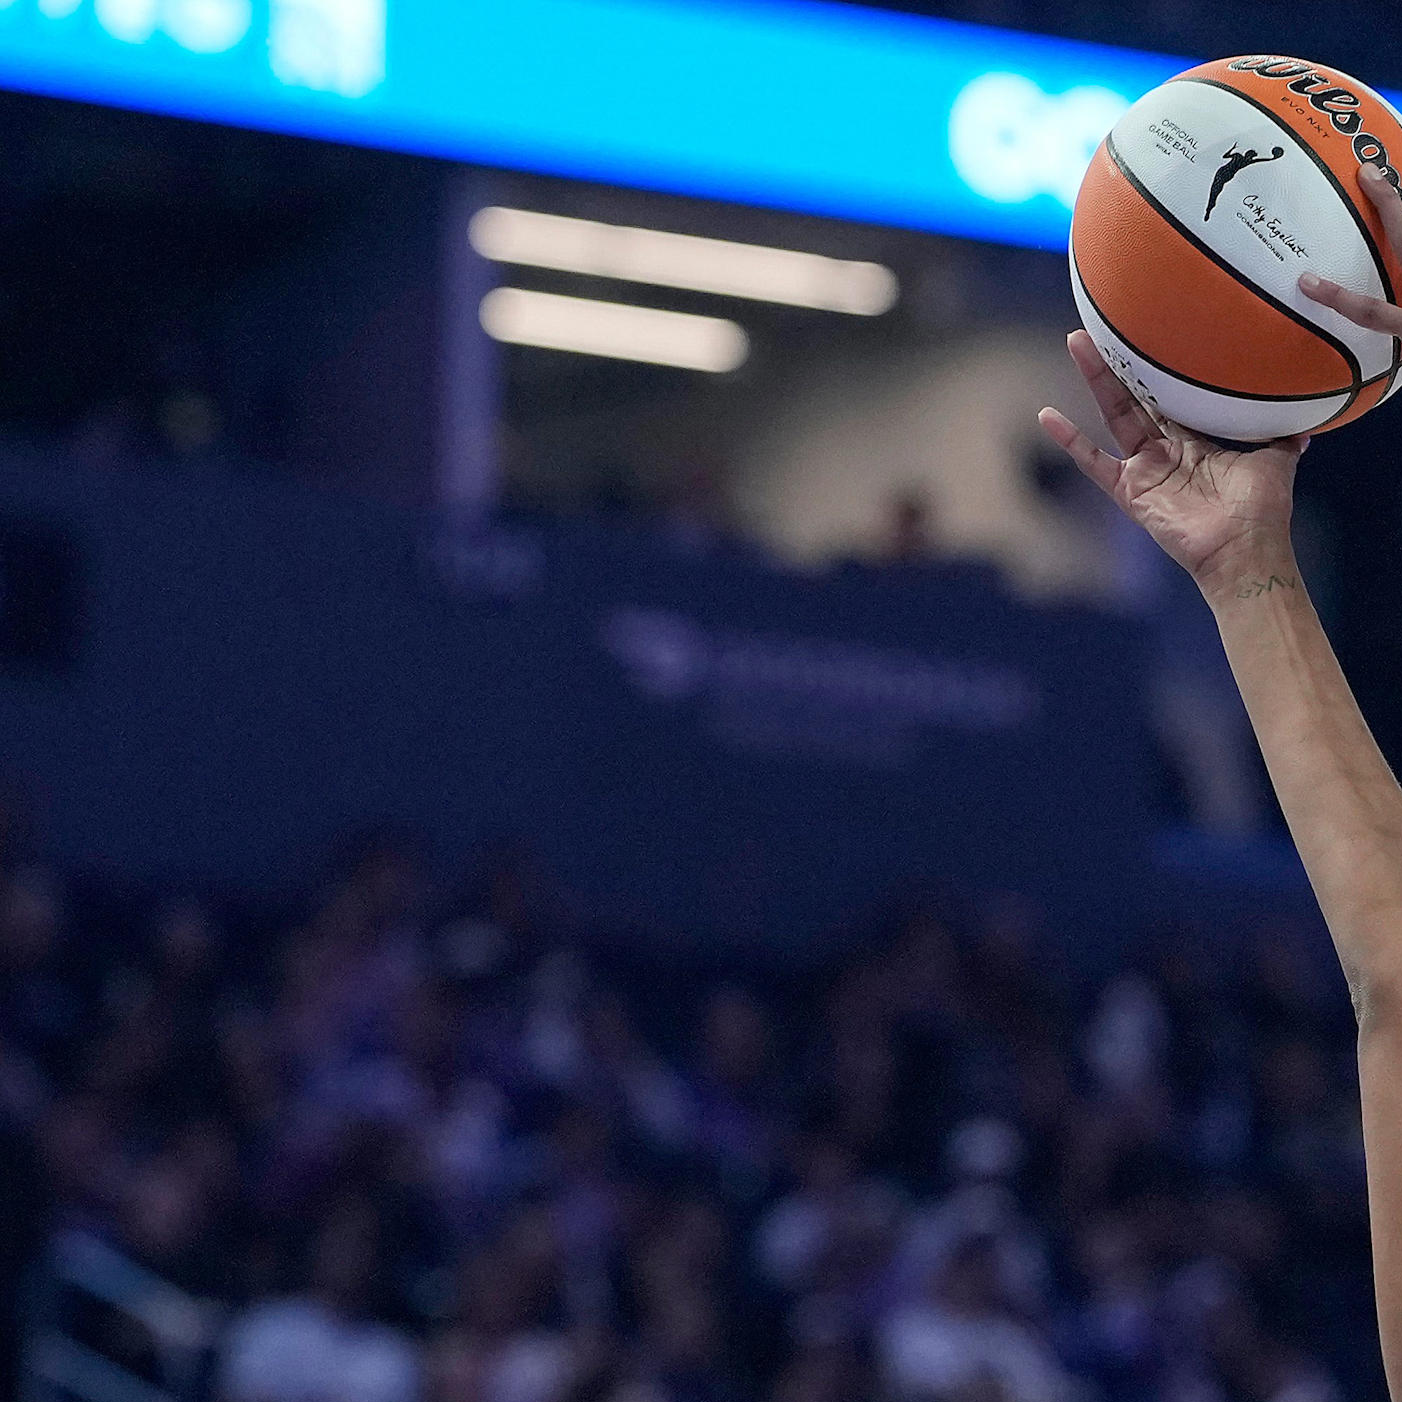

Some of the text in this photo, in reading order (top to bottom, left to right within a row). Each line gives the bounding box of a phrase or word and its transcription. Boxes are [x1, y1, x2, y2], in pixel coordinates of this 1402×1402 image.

[1161, 119, 1199, 150] OFFICIAL
[1280, 96, 1330, 140] EVO NXT
[1148, 124, 1174, 144] GAME
[1172, 141, 1197, 164] BALL
[1236, 212, 1285, 262] COMMISSIONER
